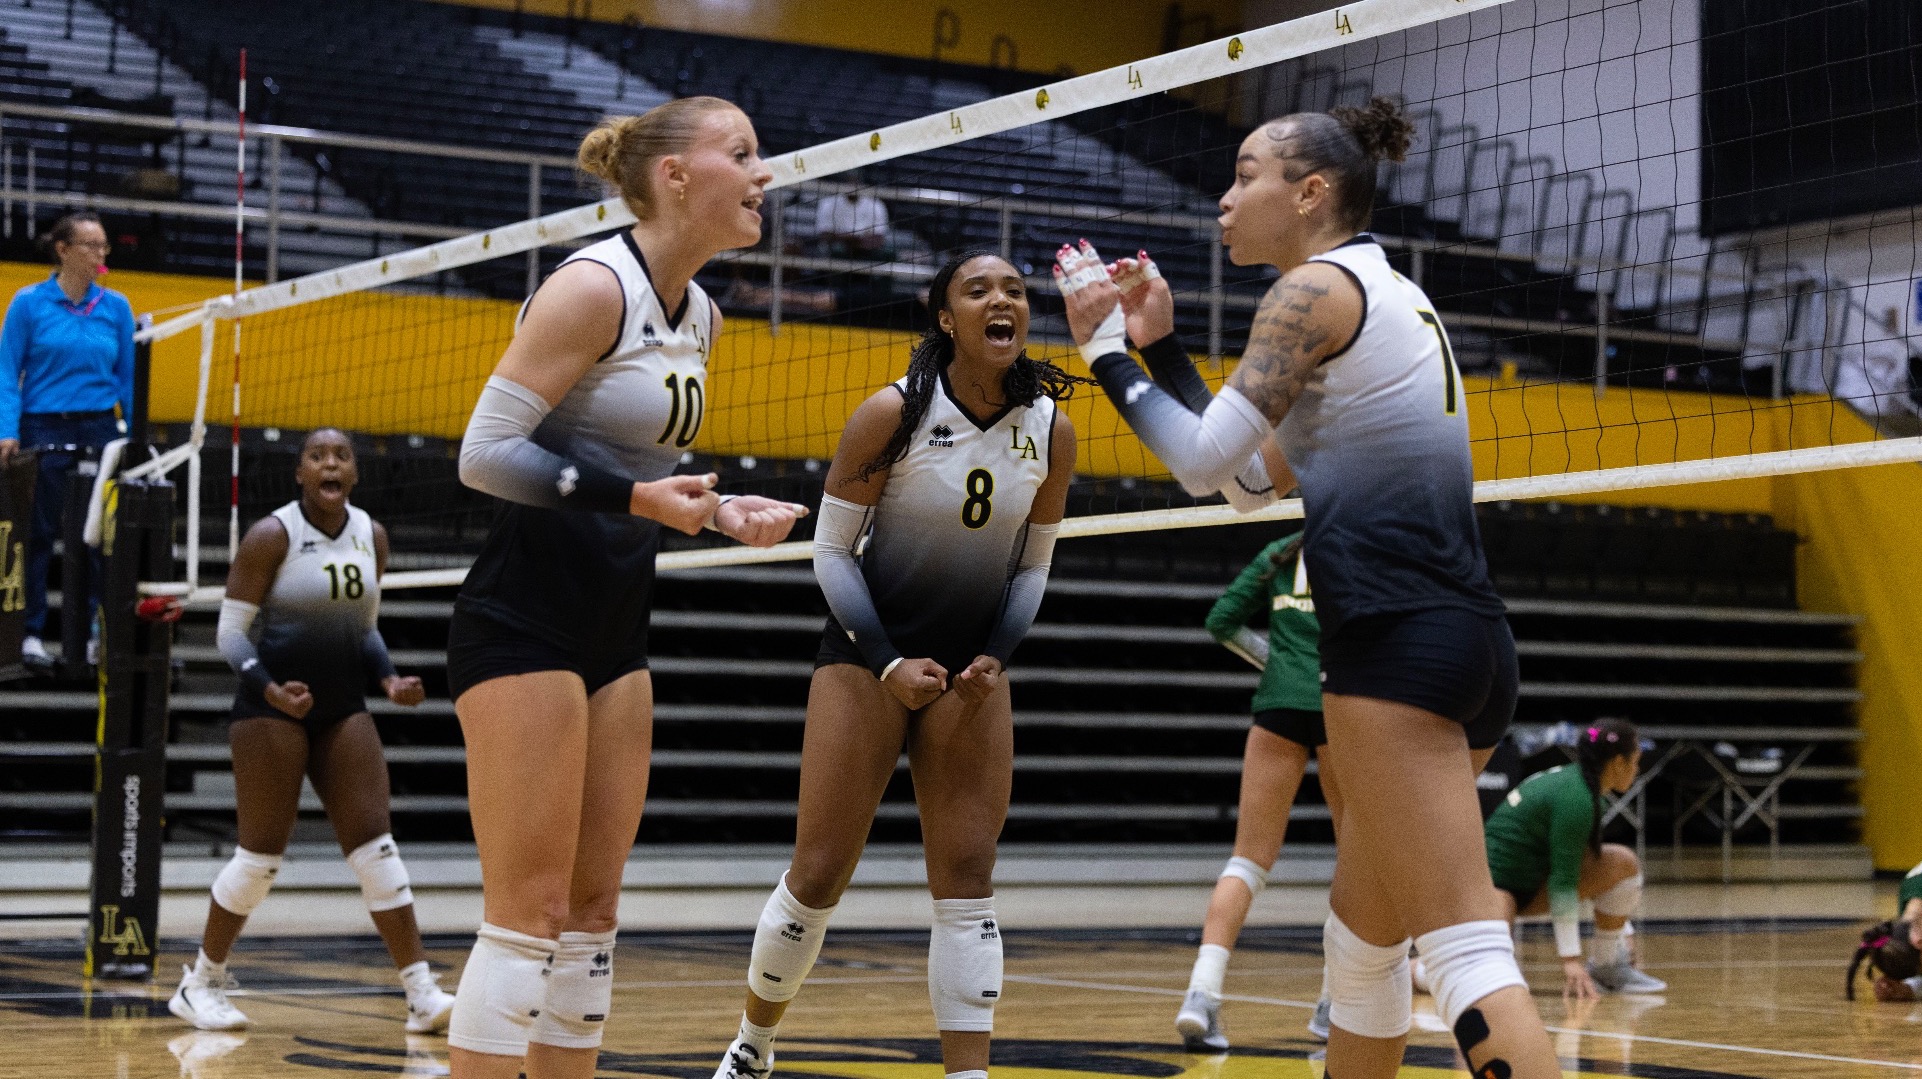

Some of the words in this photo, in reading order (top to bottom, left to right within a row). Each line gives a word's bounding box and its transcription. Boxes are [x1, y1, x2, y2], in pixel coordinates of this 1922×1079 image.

[1335, 9, 1353, 35] LA
[1127, 65, 1143, 90] LA
[950, 111, 963, 135] LA
[656, 371, 703, 449] 10
[928, 438, 954, 448] errea
[1010, 424, 1040, 461] LA
[960, 467, 995, 531] 8
[322, 563, 365, 600] 18
[99, 903, 151, 957] LA
[780, 929, 803, 943] errea
